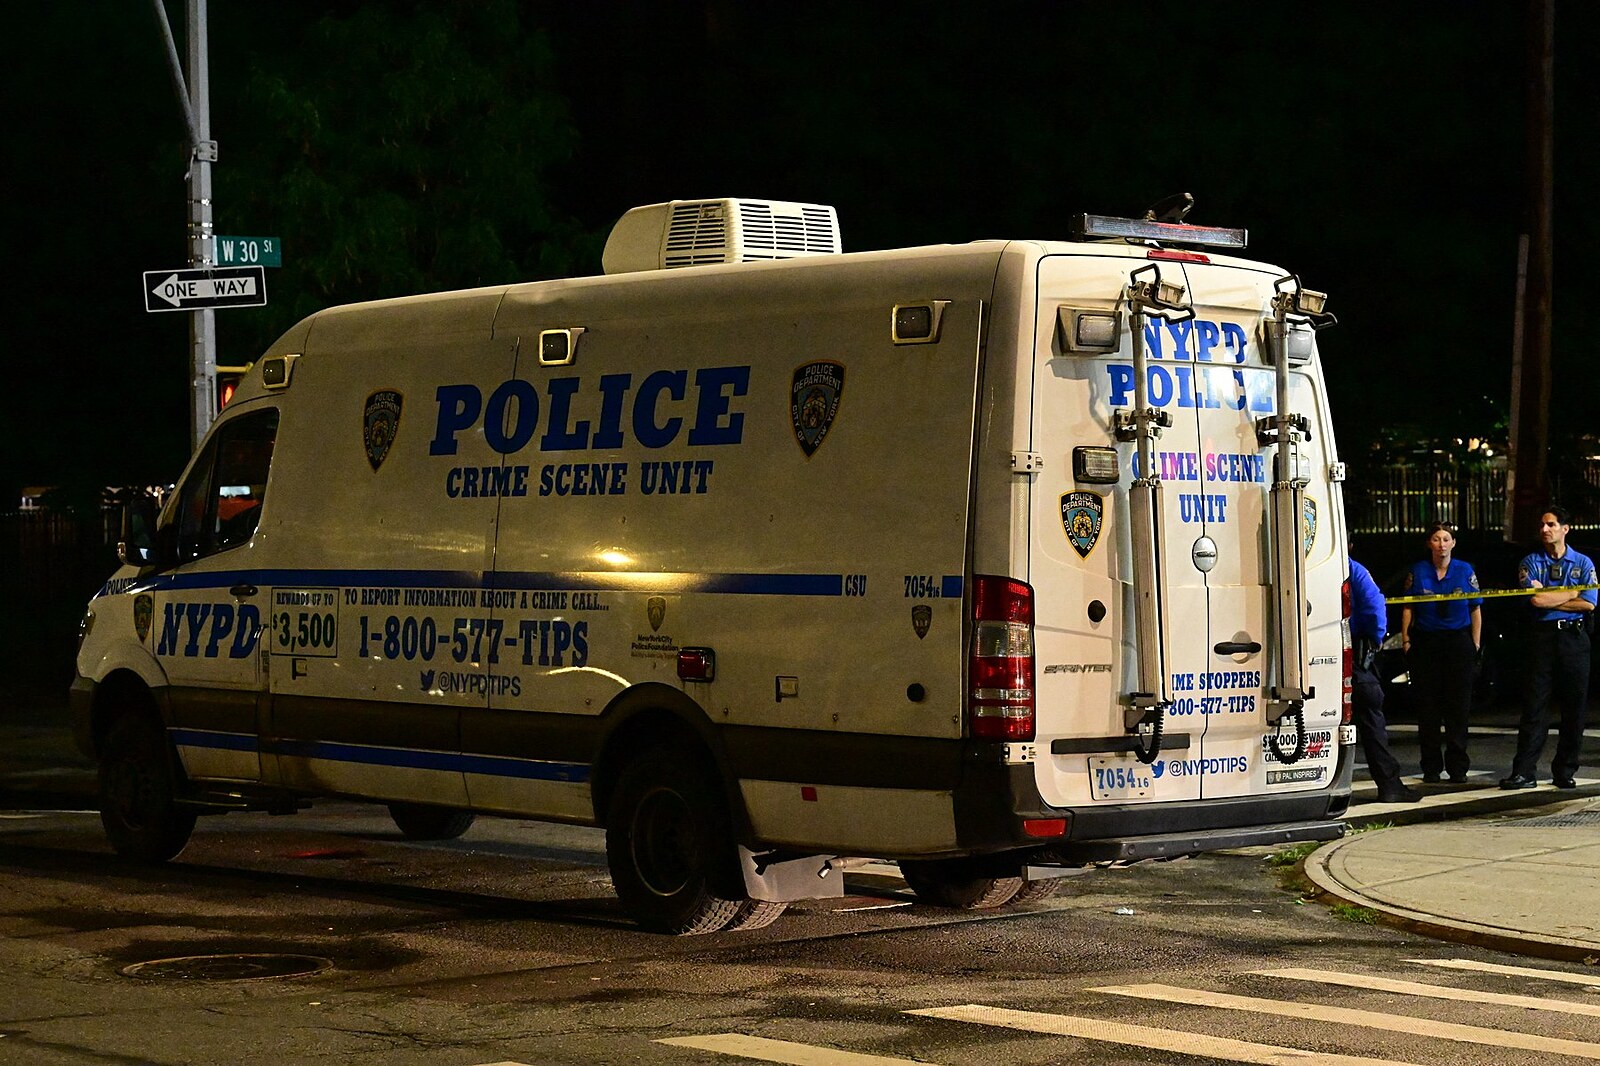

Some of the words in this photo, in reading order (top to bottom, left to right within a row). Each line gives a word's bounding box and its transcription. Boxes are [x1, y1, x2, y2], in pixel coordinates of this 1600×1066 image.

[222, 240, 234, 262] W
[240, 240, 258, 263] 30
[263, 239, 273, 253] St
[164, 282, 198, 298] ONE
[213, 279, 248, 295] WAY
[1145, 318, 1248, 364] NYPD
[805, 364, 834, 376] POLICE
[793, 374, 841, 393] DEPARTMENT
[429, 365, 751, 455] POLICE
[1132, 452, 1197, 481] CIME
[1205, 453, 1265, 482] SCENE
[446, 465, 529, 498] CRIME
[538, 462, 627, 496] SCENE
[640, 460, 714, 494] UNIT
[1062, 500, 1101, 513] DEPARTMENT
[1070, 493, 1094, 502] POLICE
[1178, 494, 1227, 523] UNIT
[1063, 519, 1073, 536] CITY
[845, 574, 866, 597] CSU
[276, 592, 310, 606] REWARDS
[312, 593, 322, 605] UP
[324, 593, 334, 606] TO
[345, 588, 357, 605] TO
[361, 588, 400, 606] REPORT
[404, 589, 477, 608] INFORMATION
[480, 591, 516, 609] ABOUT
[520, 592, 527, 609] A
[532, 592, 567, 610] CRIME
[157, 602, 261, 658] NYPD
[273, 612, 335, 652] $3,500
[359, 615, 589, 668] 1-800-577-TIPS
[1043, 663, 1113, 674] SPRINTER
[438, 671, 521, 696] @NYPDTIPS
[1199, 671, 1261, 690] STOPPERS
[1168, 756, 1248, 777] @NYPDTIPS
[1282, 772, 1292, 780] PAL
[1293, 770, 1317, 779] INSPIRES
